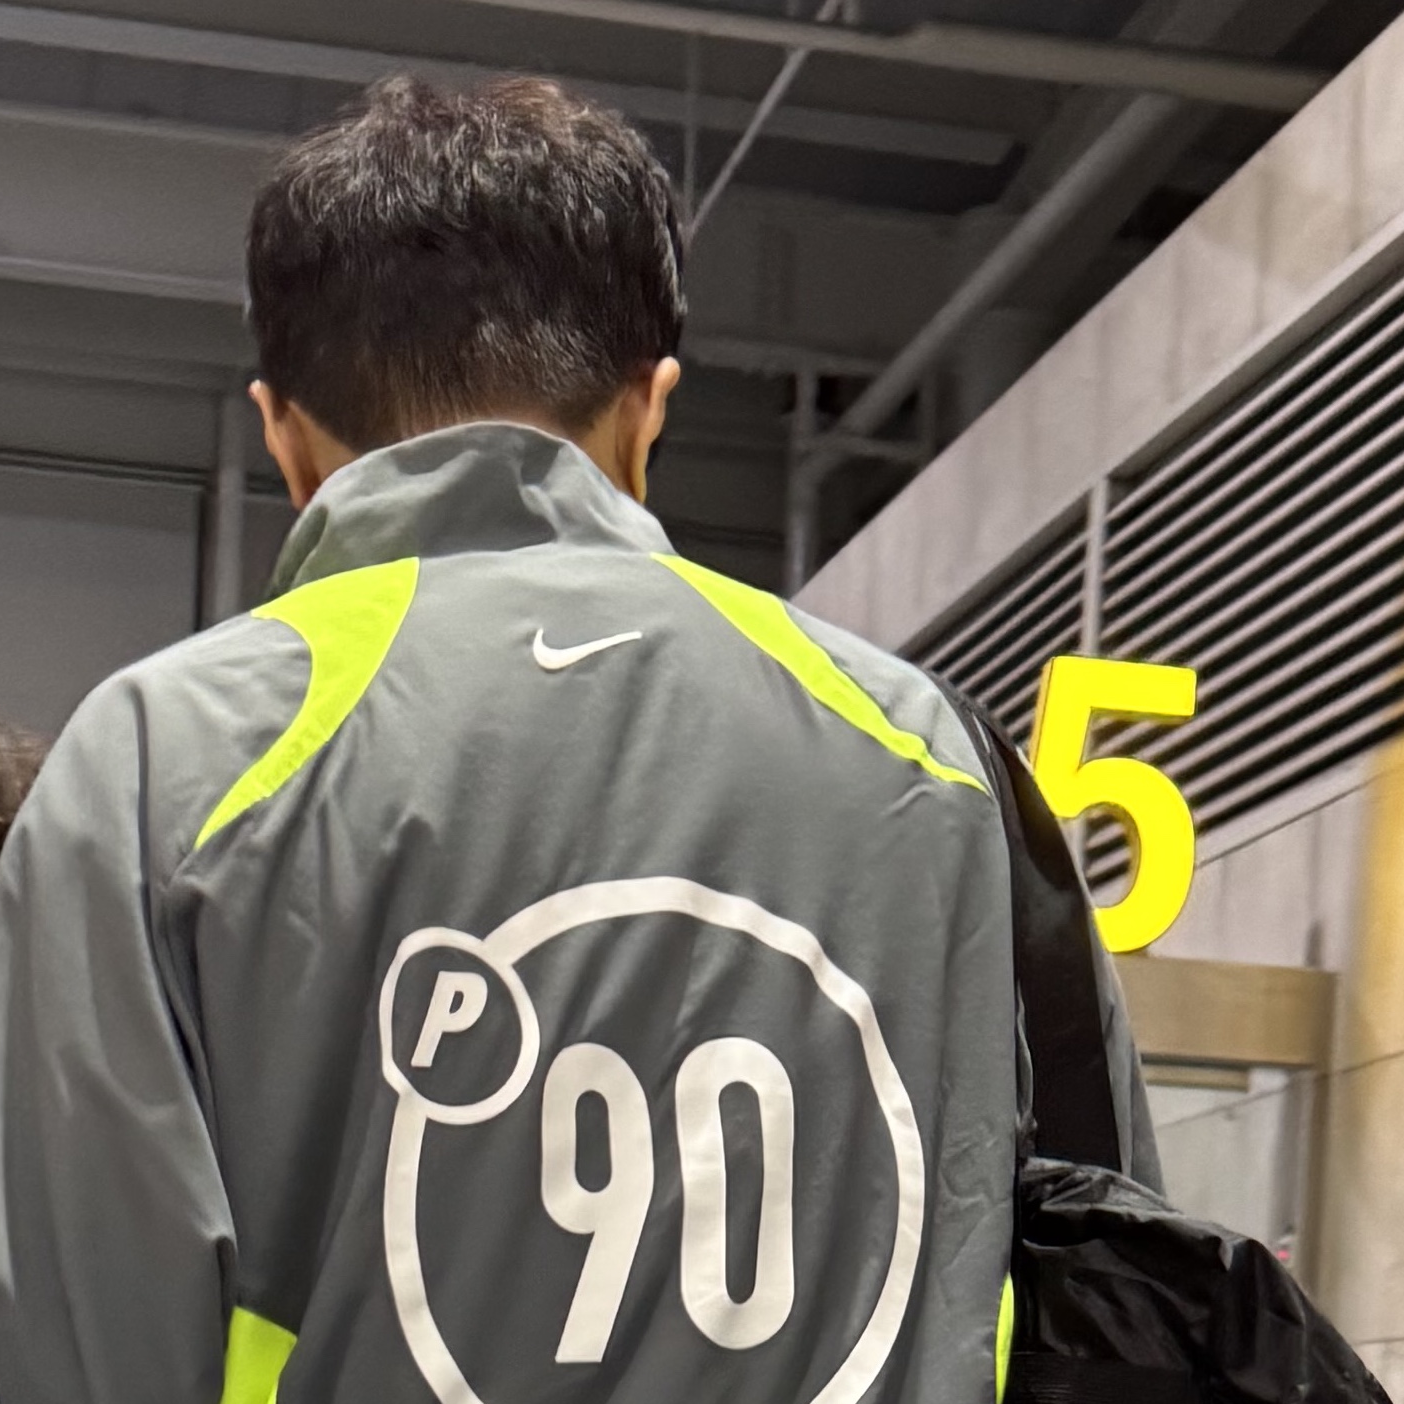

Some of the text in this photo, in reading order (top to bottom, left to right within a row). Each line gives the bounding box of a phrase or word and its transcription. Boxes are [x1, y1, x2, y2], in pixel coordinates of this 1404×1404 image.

[1030, 655, 1197, 953] 5
[411, 971, 488, 1067] P
[541, 1037, 794, 1363] 90
